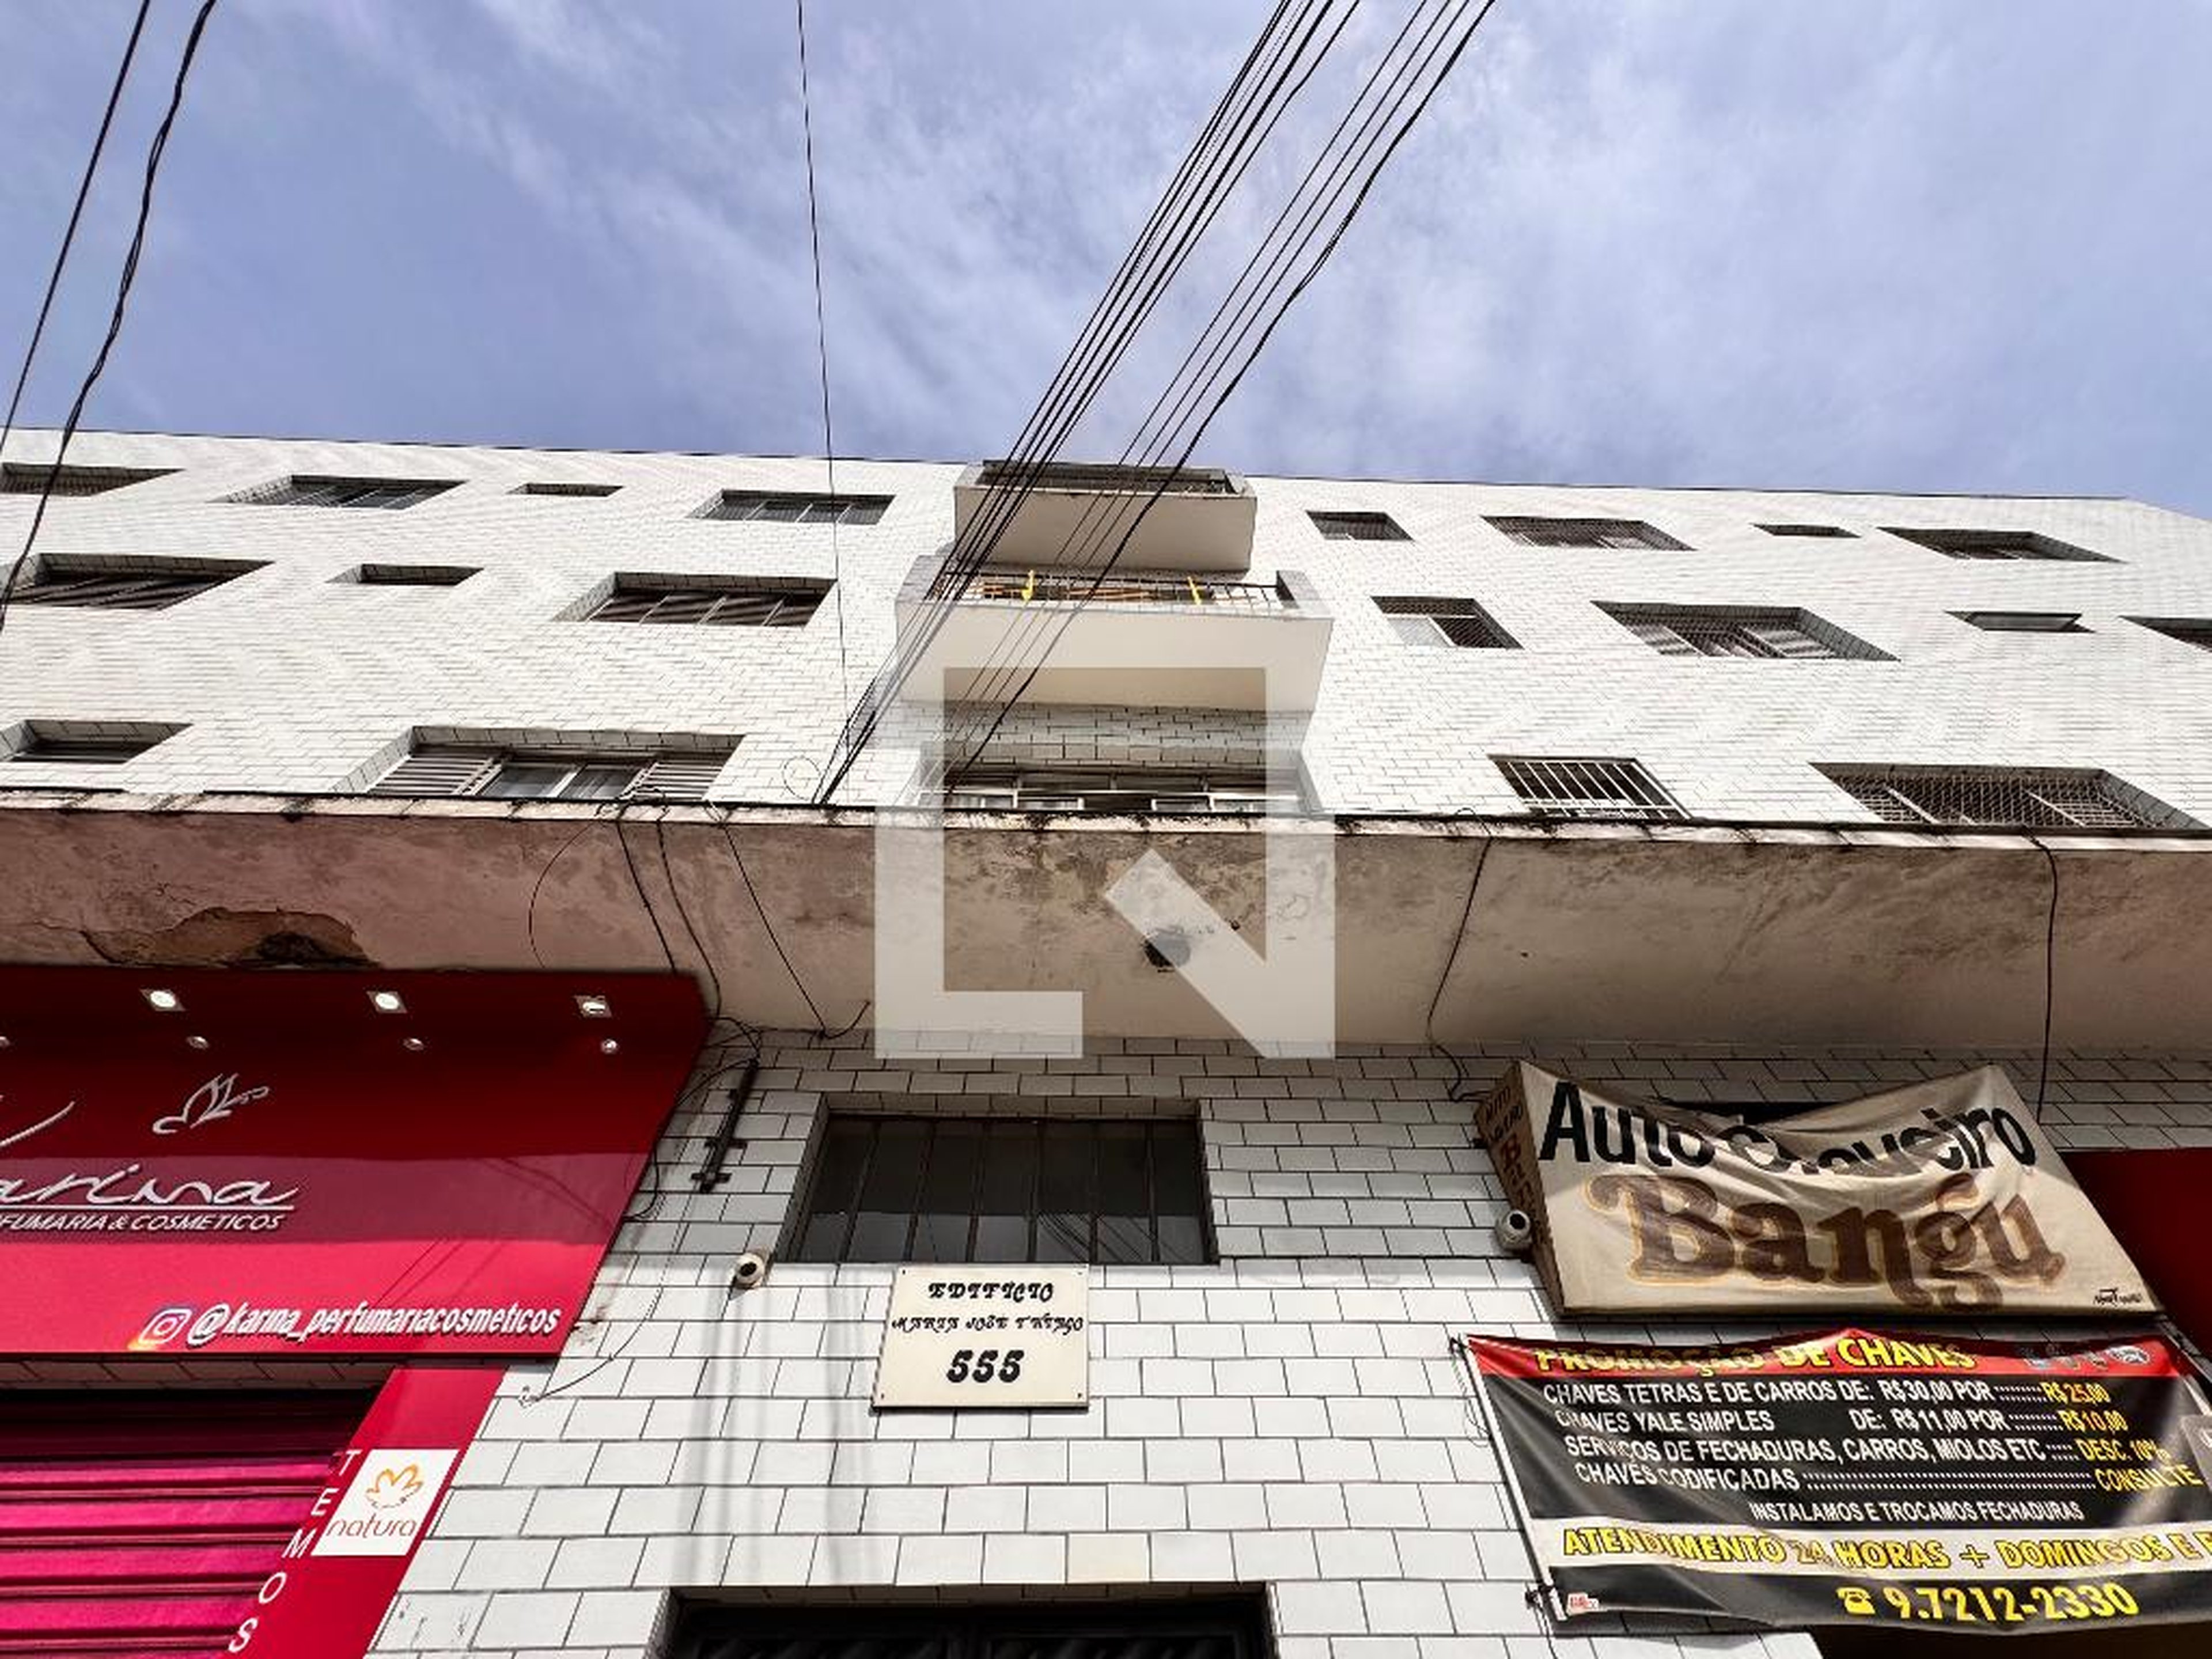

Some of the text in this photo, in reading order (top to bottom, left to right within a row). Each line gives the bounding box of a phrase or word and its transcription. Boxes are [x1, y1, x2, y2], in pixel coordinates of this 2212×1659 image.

[1540, 1081, 1716, 1167] Auto
[130, 1213, 285, 1231] COSMETICOS
[1580, 1172, 2067, 1309] Bangu
[891, 1316, 960, 1333] MARIA
[946, 1349, 1025, 1384] 555
[1779, 1340, 1833, 1368] DE
[1836, 1337, 1978, 1369] CHAVES
[1544, 1384, 1622, 1404] CHAVES
[1624, 1383, 1703, 1404] TETRAS
[1709, 1383, 1722, 1403] E
[1724, 1383, 1753, 1403] DE
[1754, 1381, 1838, 1402] CARROS
[1842, 1381, 1874, 1401] DE:
[1953, 1381, 1996, 1402] POR
[1555, 1409, 1638, 1433] CHAVES
[1633, 1411, 1689, 1433] YALE
[1688, 1409, 1775, 1432] SIMPLES
[1967, 1408, 2013, 1431] POR
[1564, 1435, 1662, 1464] SERVIÇOS
[1666, 1440, 1693, 1462] DE
[1696, 1439, 1843, 1465] FECHADURAS,
[1845, 1438, 1937, 1464] CARROS,
[1934, 1438, 2011, 1461] MIOLOS
[1658, 1467, 1801, 1491] CODIFICADAS
[2094, 1464, 2205, 1492] CONSULTE
[326, 1512, 418, 1539] natura
[1749, 1500, 2085, 1523] INSTALAMOS E TROCAMOS FECHADURAS
[1563, 1528, 1787, 1564] ATENDIMENTO
[1830, 1539, 1952, 1569] HORAS
[1960, 1544, 1989, 1568] +
[1994, 1533, 2175, 1569] DOMINGOS
[2166, 1532, 2205, 1560] E
[1883, 1582, 2139, 1622] 9.7212-2330
